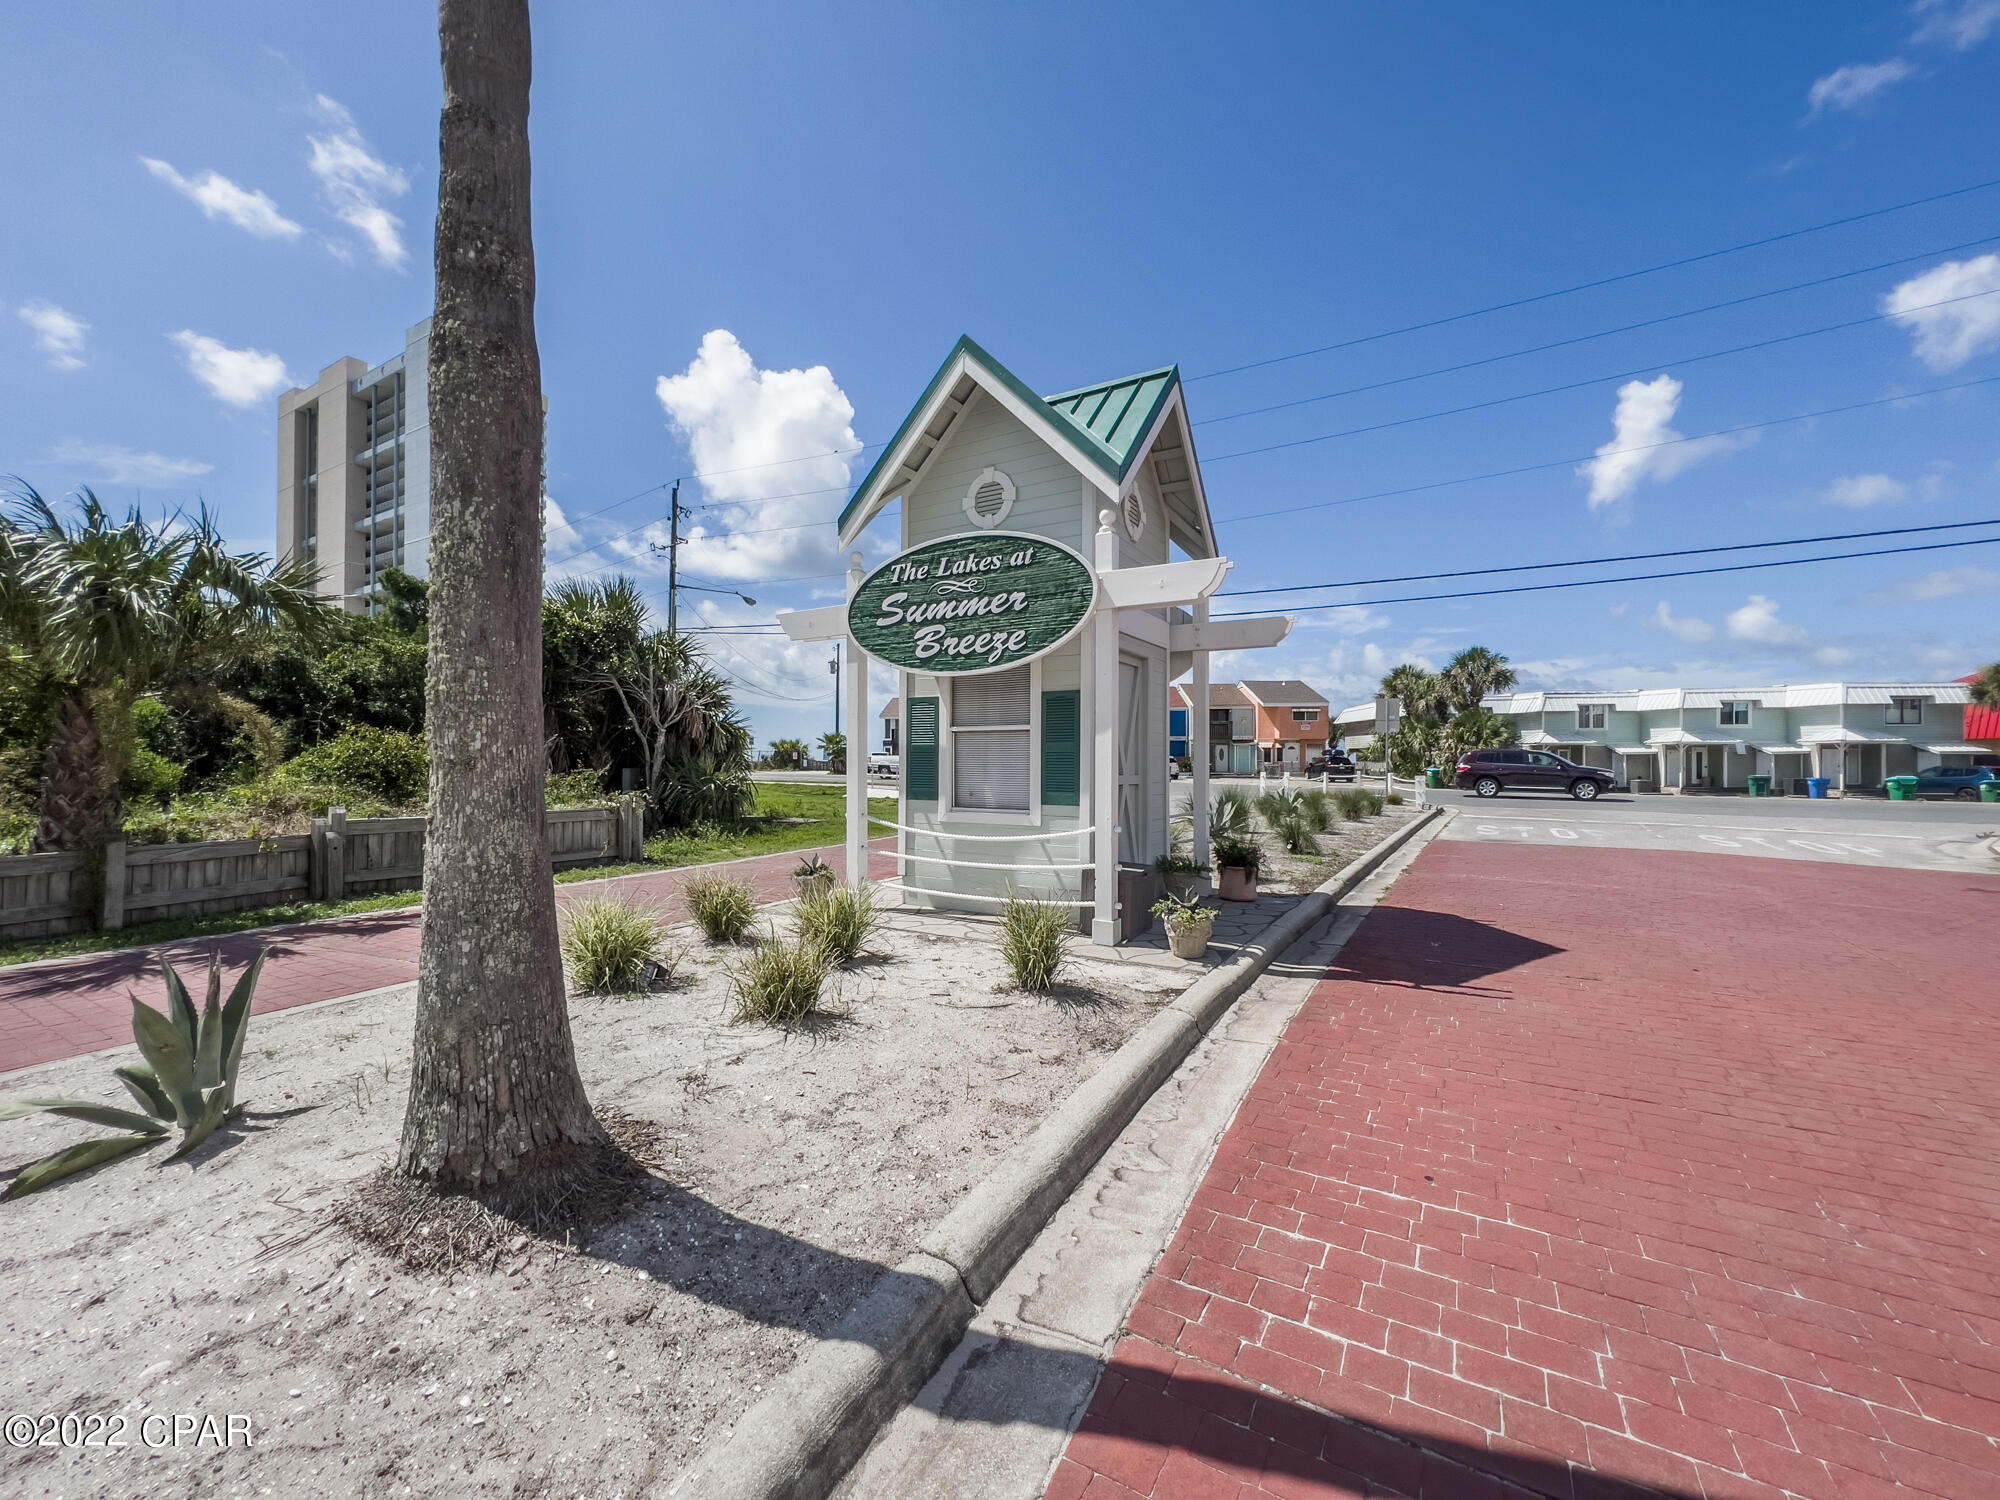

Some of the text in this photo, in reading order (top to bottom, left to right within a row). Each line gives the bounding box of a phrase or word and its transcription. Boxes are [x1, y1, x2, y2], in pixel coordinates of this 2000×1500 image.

[891, 547, 1035, 584] The Lakes at
[876, 591, 1028, 627] Summer
[913, 624, 1027, 663] Breeze
[1697, 834, 1884, 857] STOP
